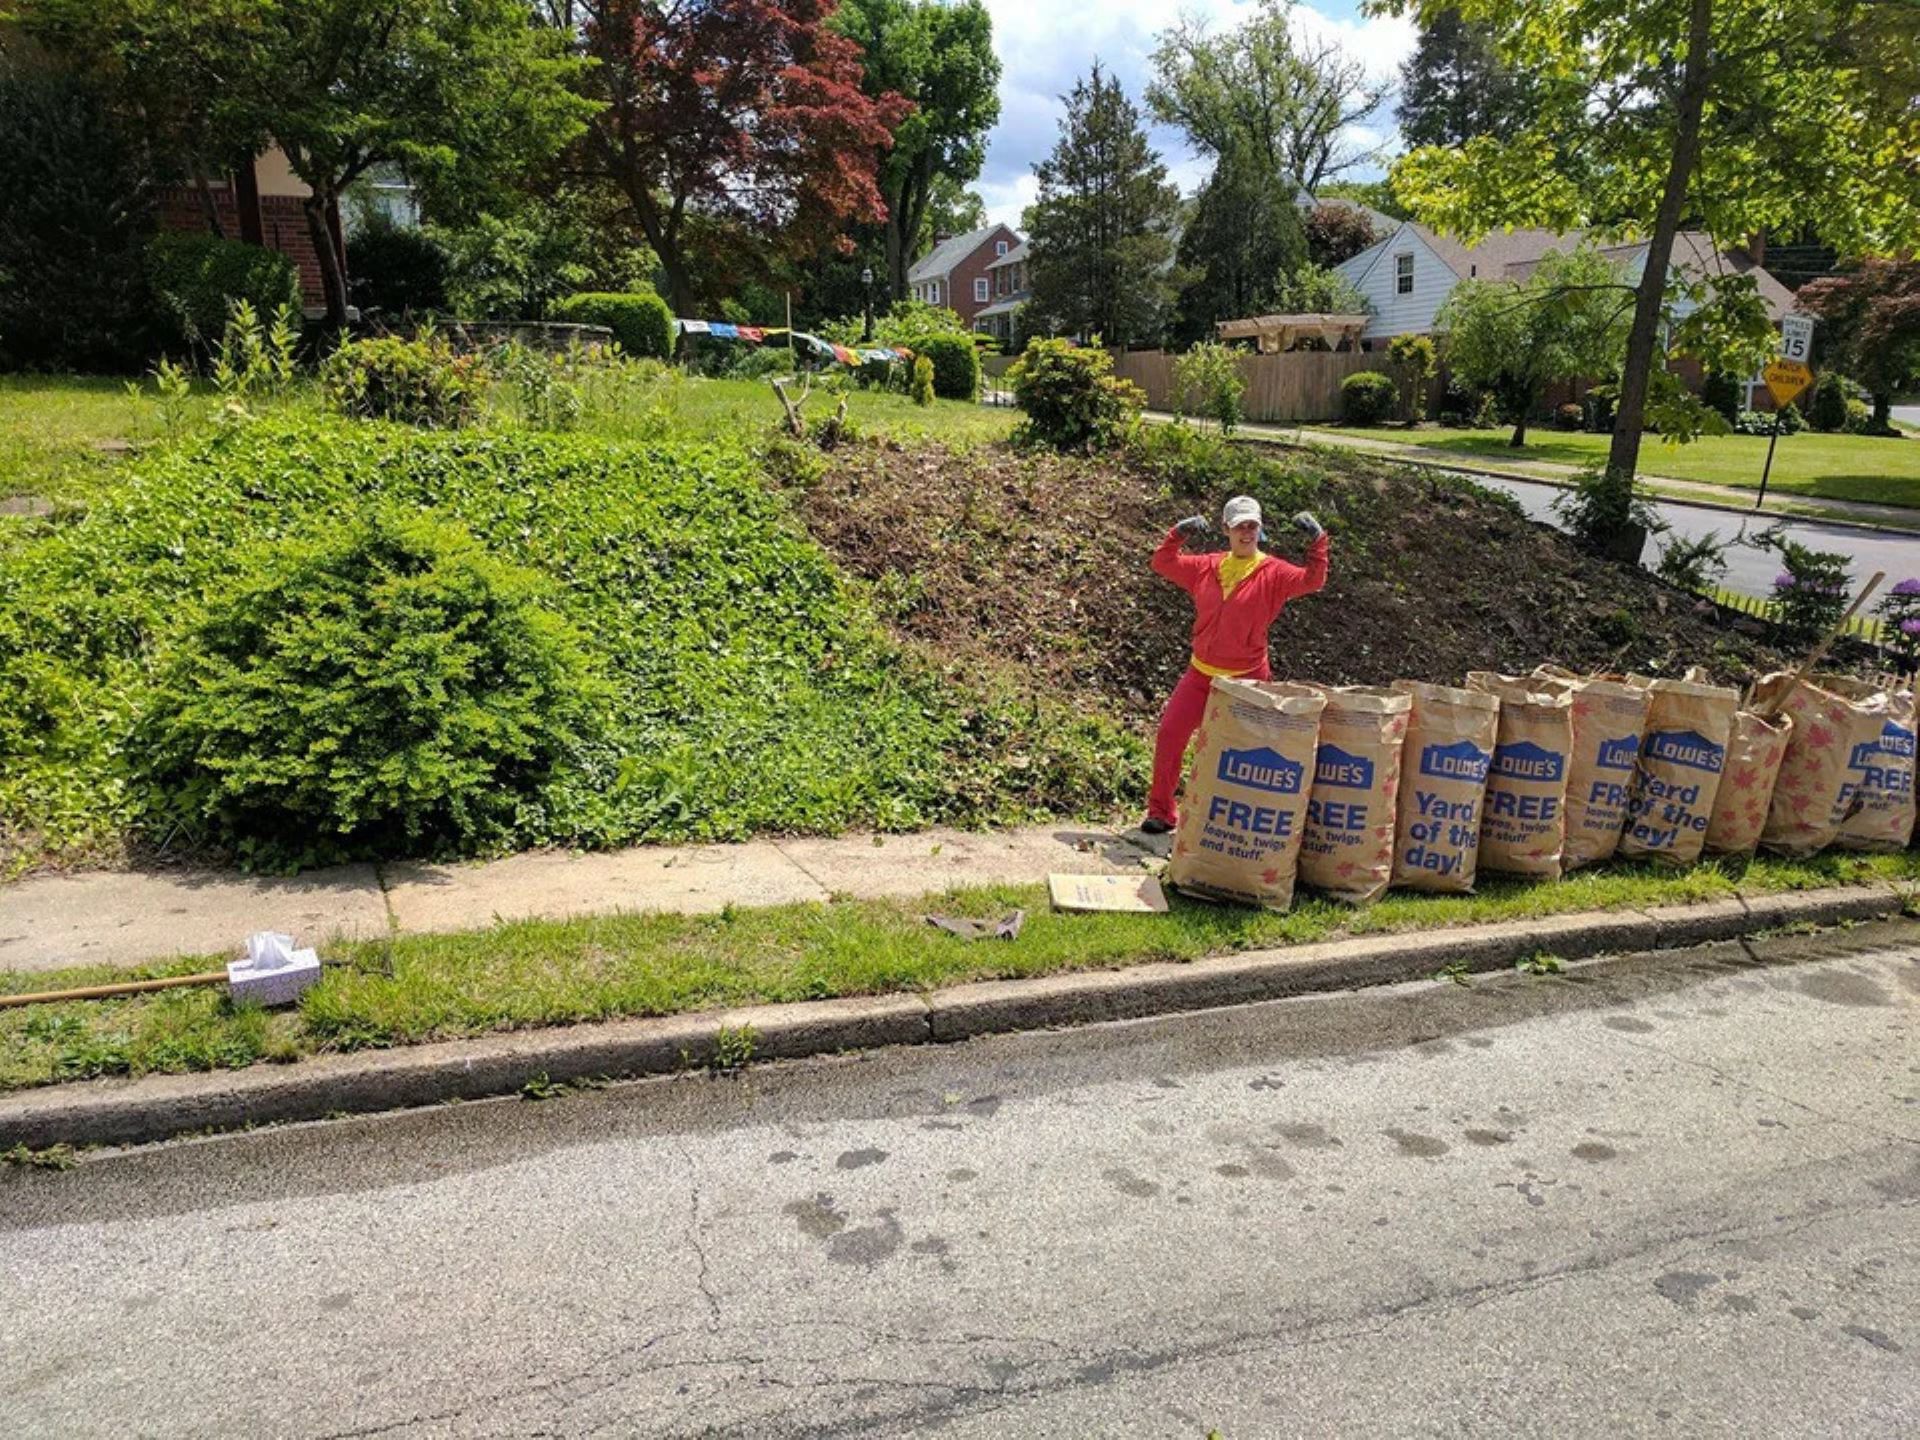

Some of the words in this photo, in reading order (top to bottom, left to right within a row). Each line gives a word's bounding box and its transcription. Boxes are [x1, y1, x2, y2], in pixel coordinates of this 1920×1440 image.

[1784, 337, 1805, 357] 15
[1430, 751, 1487, 779] LOWE'S
[1652, 737, 1720, 769] LOWE'S
[1226, 756, 1296, 789] LOWE'S
[1319, 763, 1364, 784] WE'S
[1209, 795, 1295, 836] FREE
[1308, 799, 1368, 830] REE
[1415, 791, 1475, 821] Yard
[1663, 803, 1709, 832] the
[1199, 838, 1224, 853] and
[1410, 822, 1442, 843] of
[1448, 825, 1476, 848] the
[1405, 845, 1462, 876] day!
